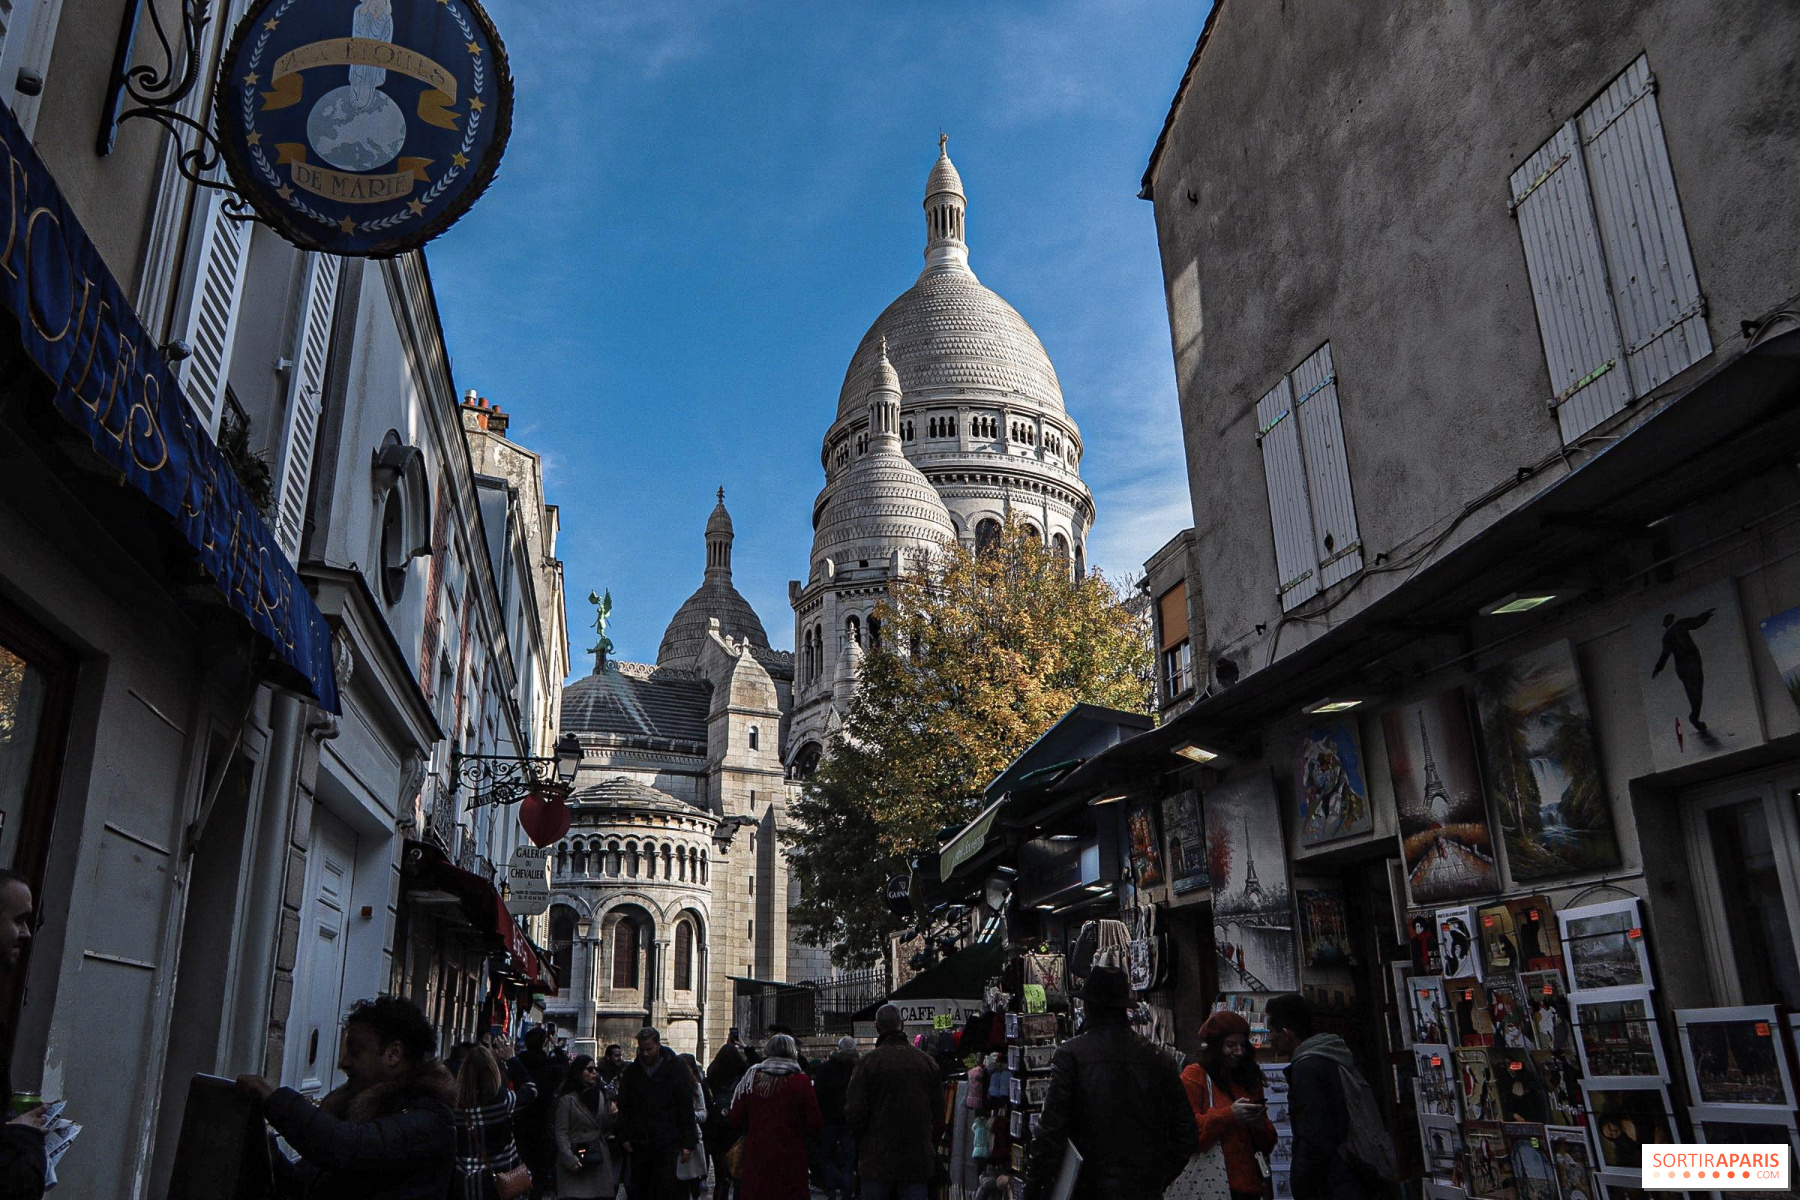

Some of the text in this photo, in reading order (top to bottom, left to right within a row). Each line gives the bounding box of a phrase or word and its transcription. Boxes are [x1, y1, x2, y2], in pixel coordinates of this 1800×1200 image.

[295, 165, 407, 199] DE MARIE
[516, 848, 547, 859] GALERIE
[510, 868, 544, 879] CHEVALIER
[901, 1007, 935, 1021] CAFE
